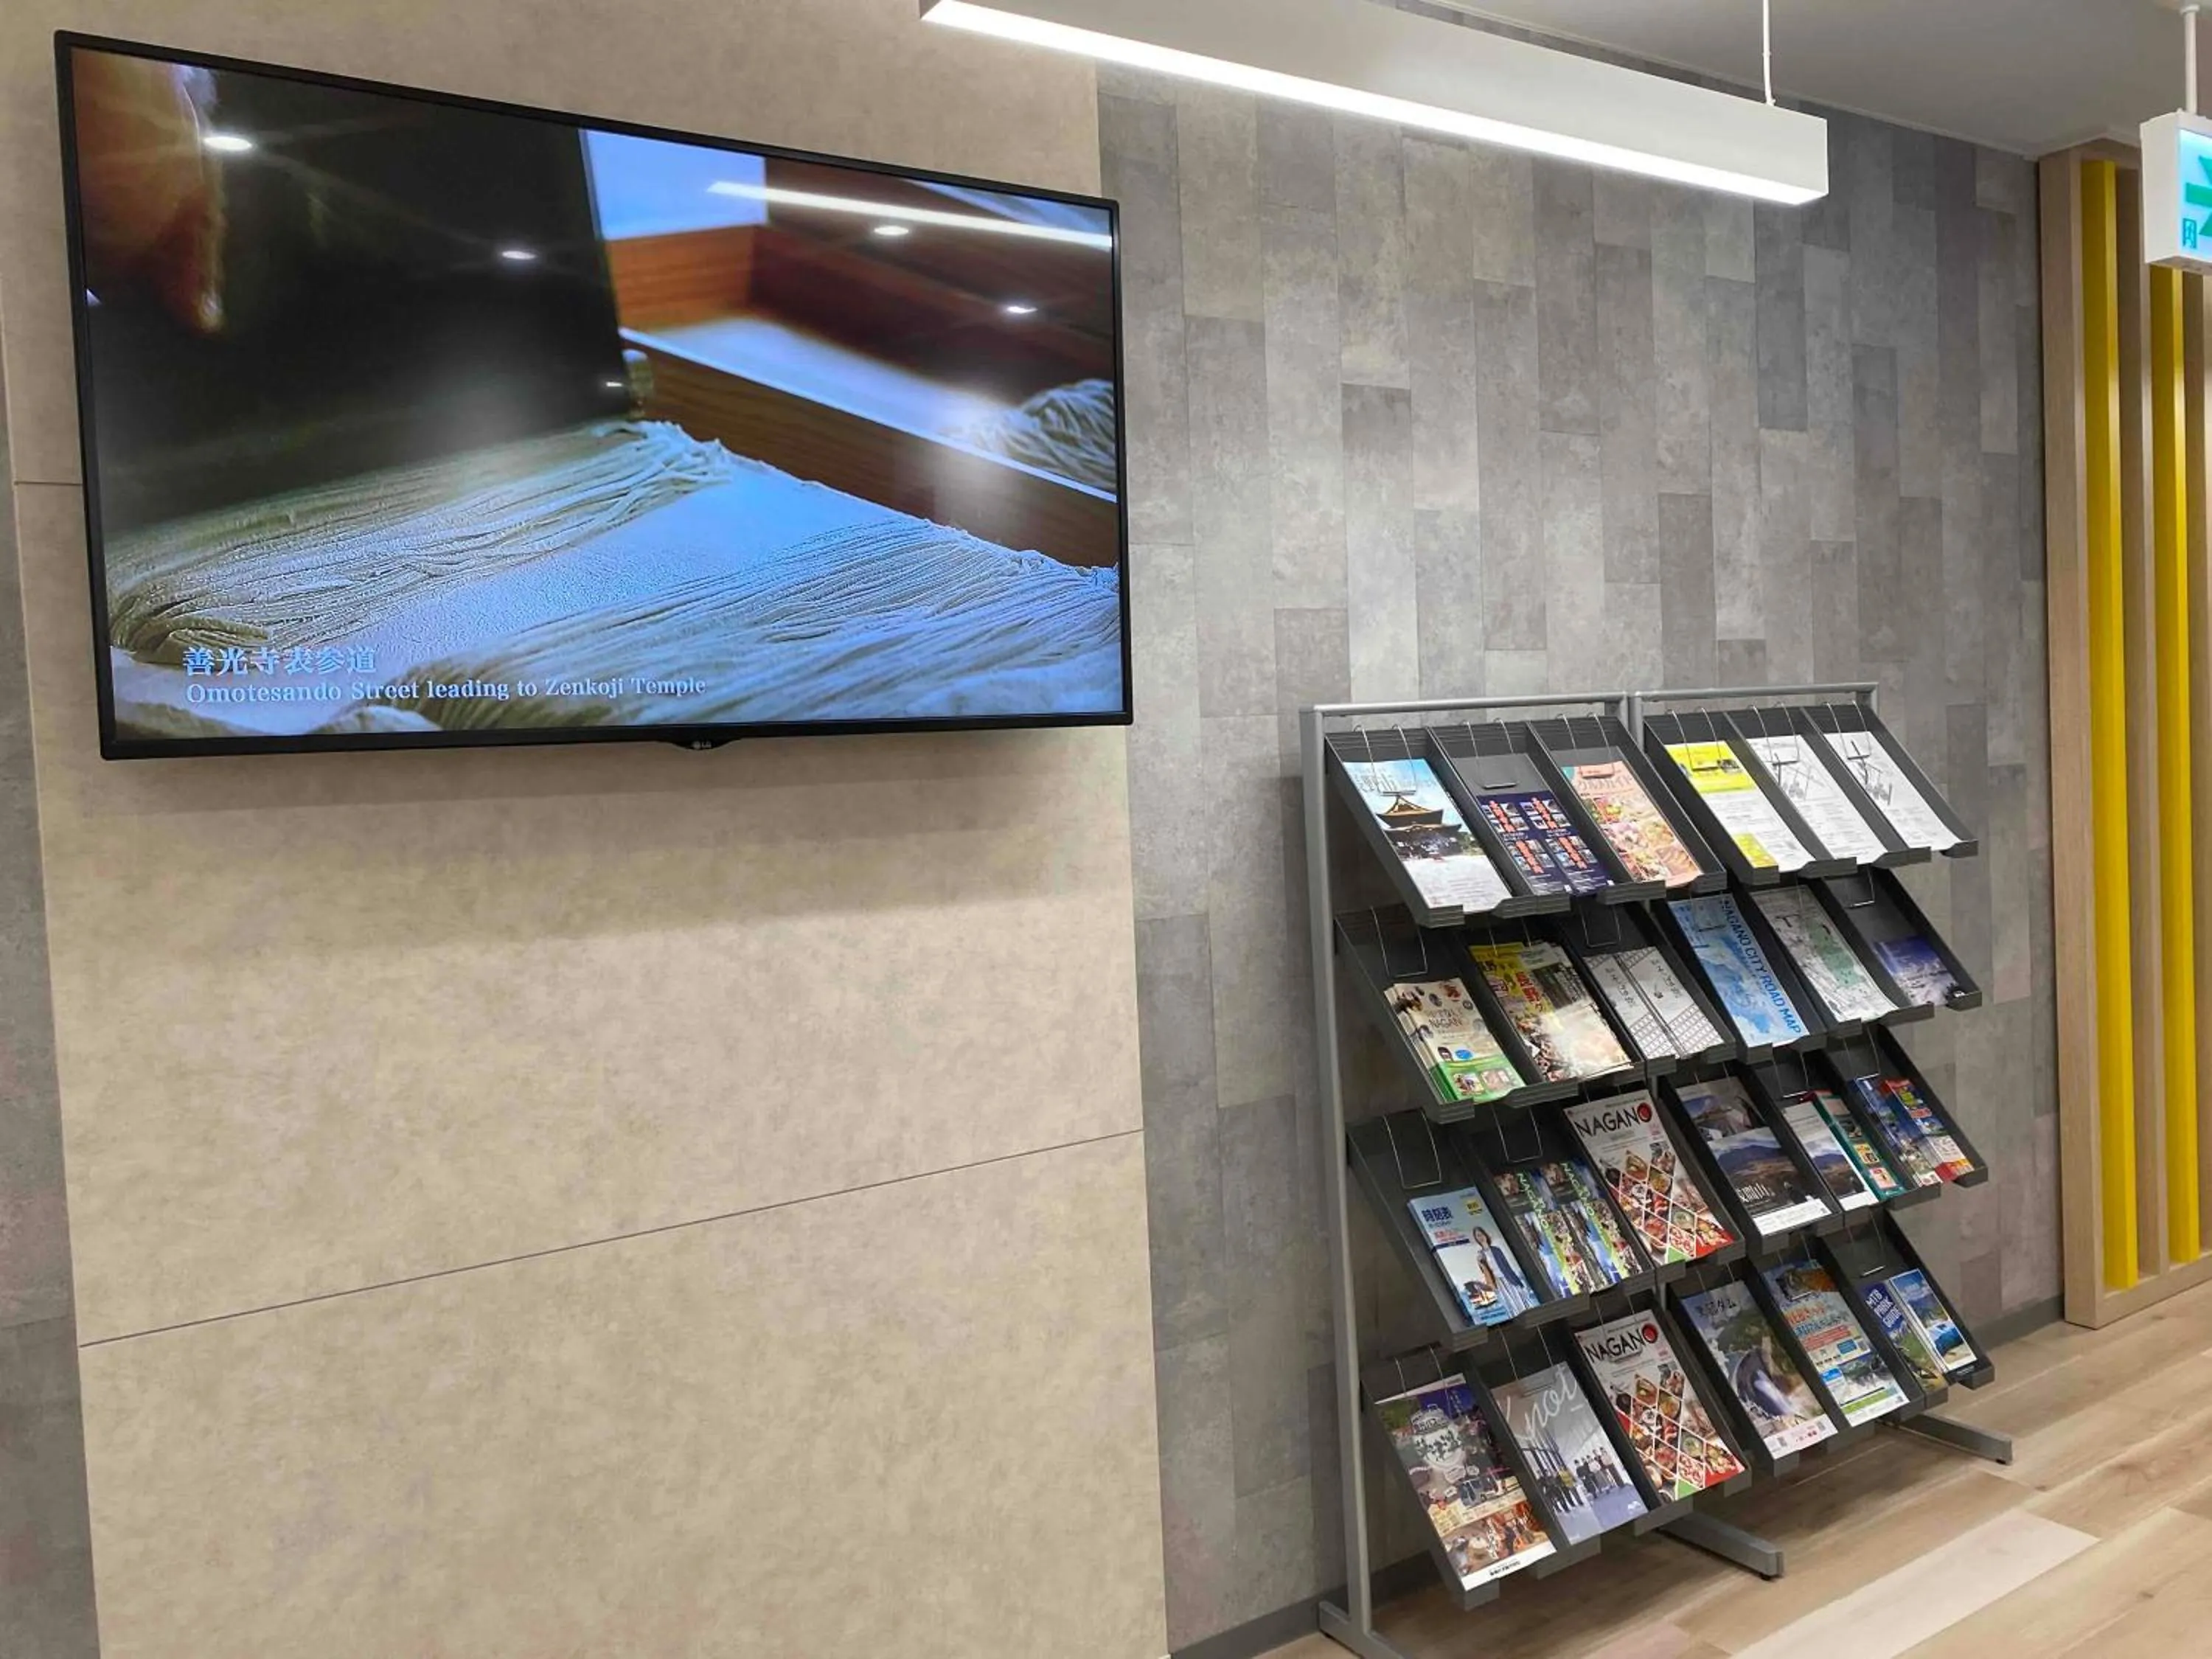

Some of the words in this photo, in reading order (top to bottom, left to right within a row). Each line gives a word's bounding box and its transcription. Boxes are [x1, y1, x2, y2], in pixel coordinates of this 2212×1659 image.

[183, 647, 377, 676] 善光寺表参道
[187, 682, 341, 703] Omotesando
[351, 681, 420, 700] Street
[427, 679, 509, 700] leading
[517, 680, 538, 697] to
[545, 678, 624, 699] Zenkoji
[630, 677, 706, 698] Temple
[1745, 947, 1767, 973] CITY
[1761, 974, 1786, 1007] ROAD
[1779, 1008, 1801, 1033] MAP
[1574, 1102, 1652, 1137] NAGANO
[1584, 1324, 1658, 1363] NAGANO
